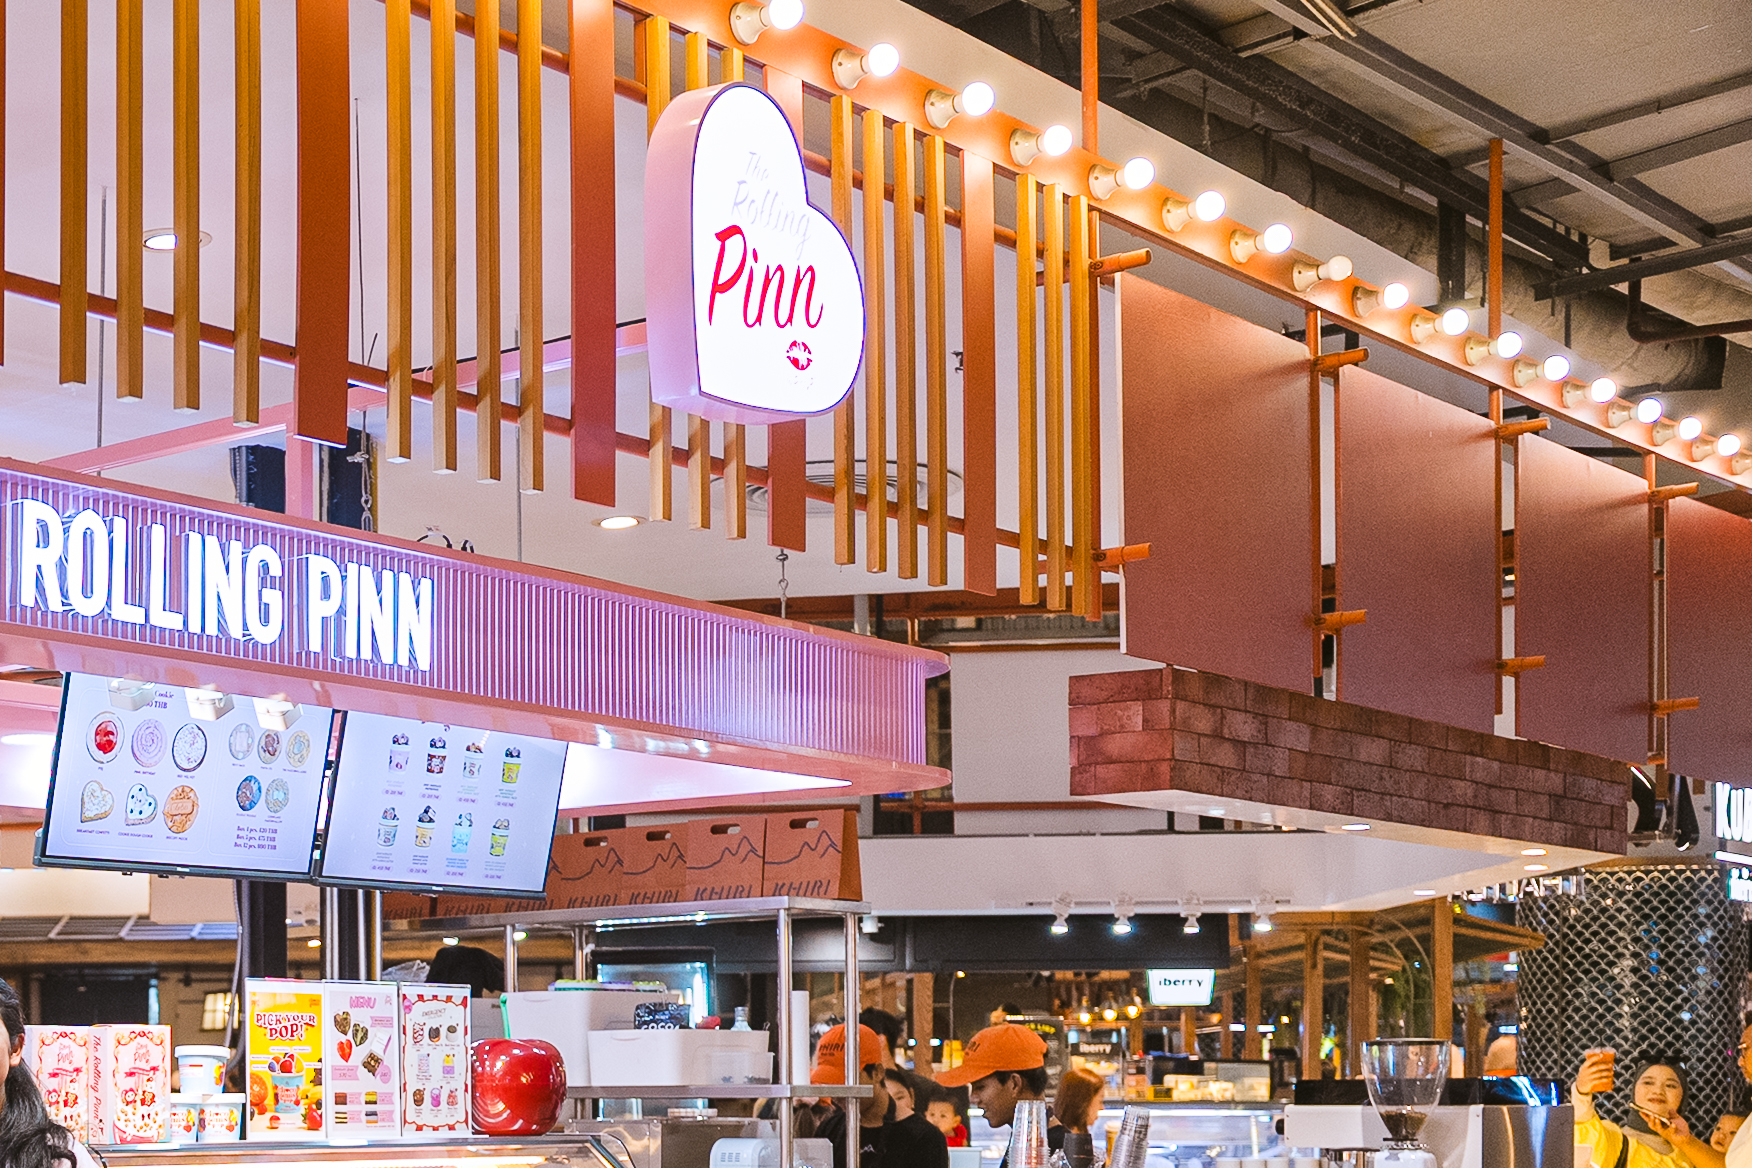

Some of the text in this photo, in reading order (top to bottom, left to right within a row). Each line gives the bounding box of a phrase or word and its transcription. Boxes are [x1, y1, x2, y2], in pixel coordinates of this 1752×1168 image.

[708, 225, 824, 328] Pinn
[21, 500, 284, 645] ROLLING
[306, 553, 433, 671] PINN
[694, 884, 752, 901] KHIRI
[772, 879, 831, 897] KHIRI
[567, 893, 618, 908] KHIRI
[629, 889, 679, 905] KHIRI
[1159, 978, 1204, 988] iberry
[349, 995, 377, 1009] MENU
[256, 1013, 316, 1026] PICK YOUR
[269, 1022, 304, 1039] POP!
[1079, 1042, 1112, 1054] iberry
[90, 1035, 102, 1120] The Rolling Pinn
